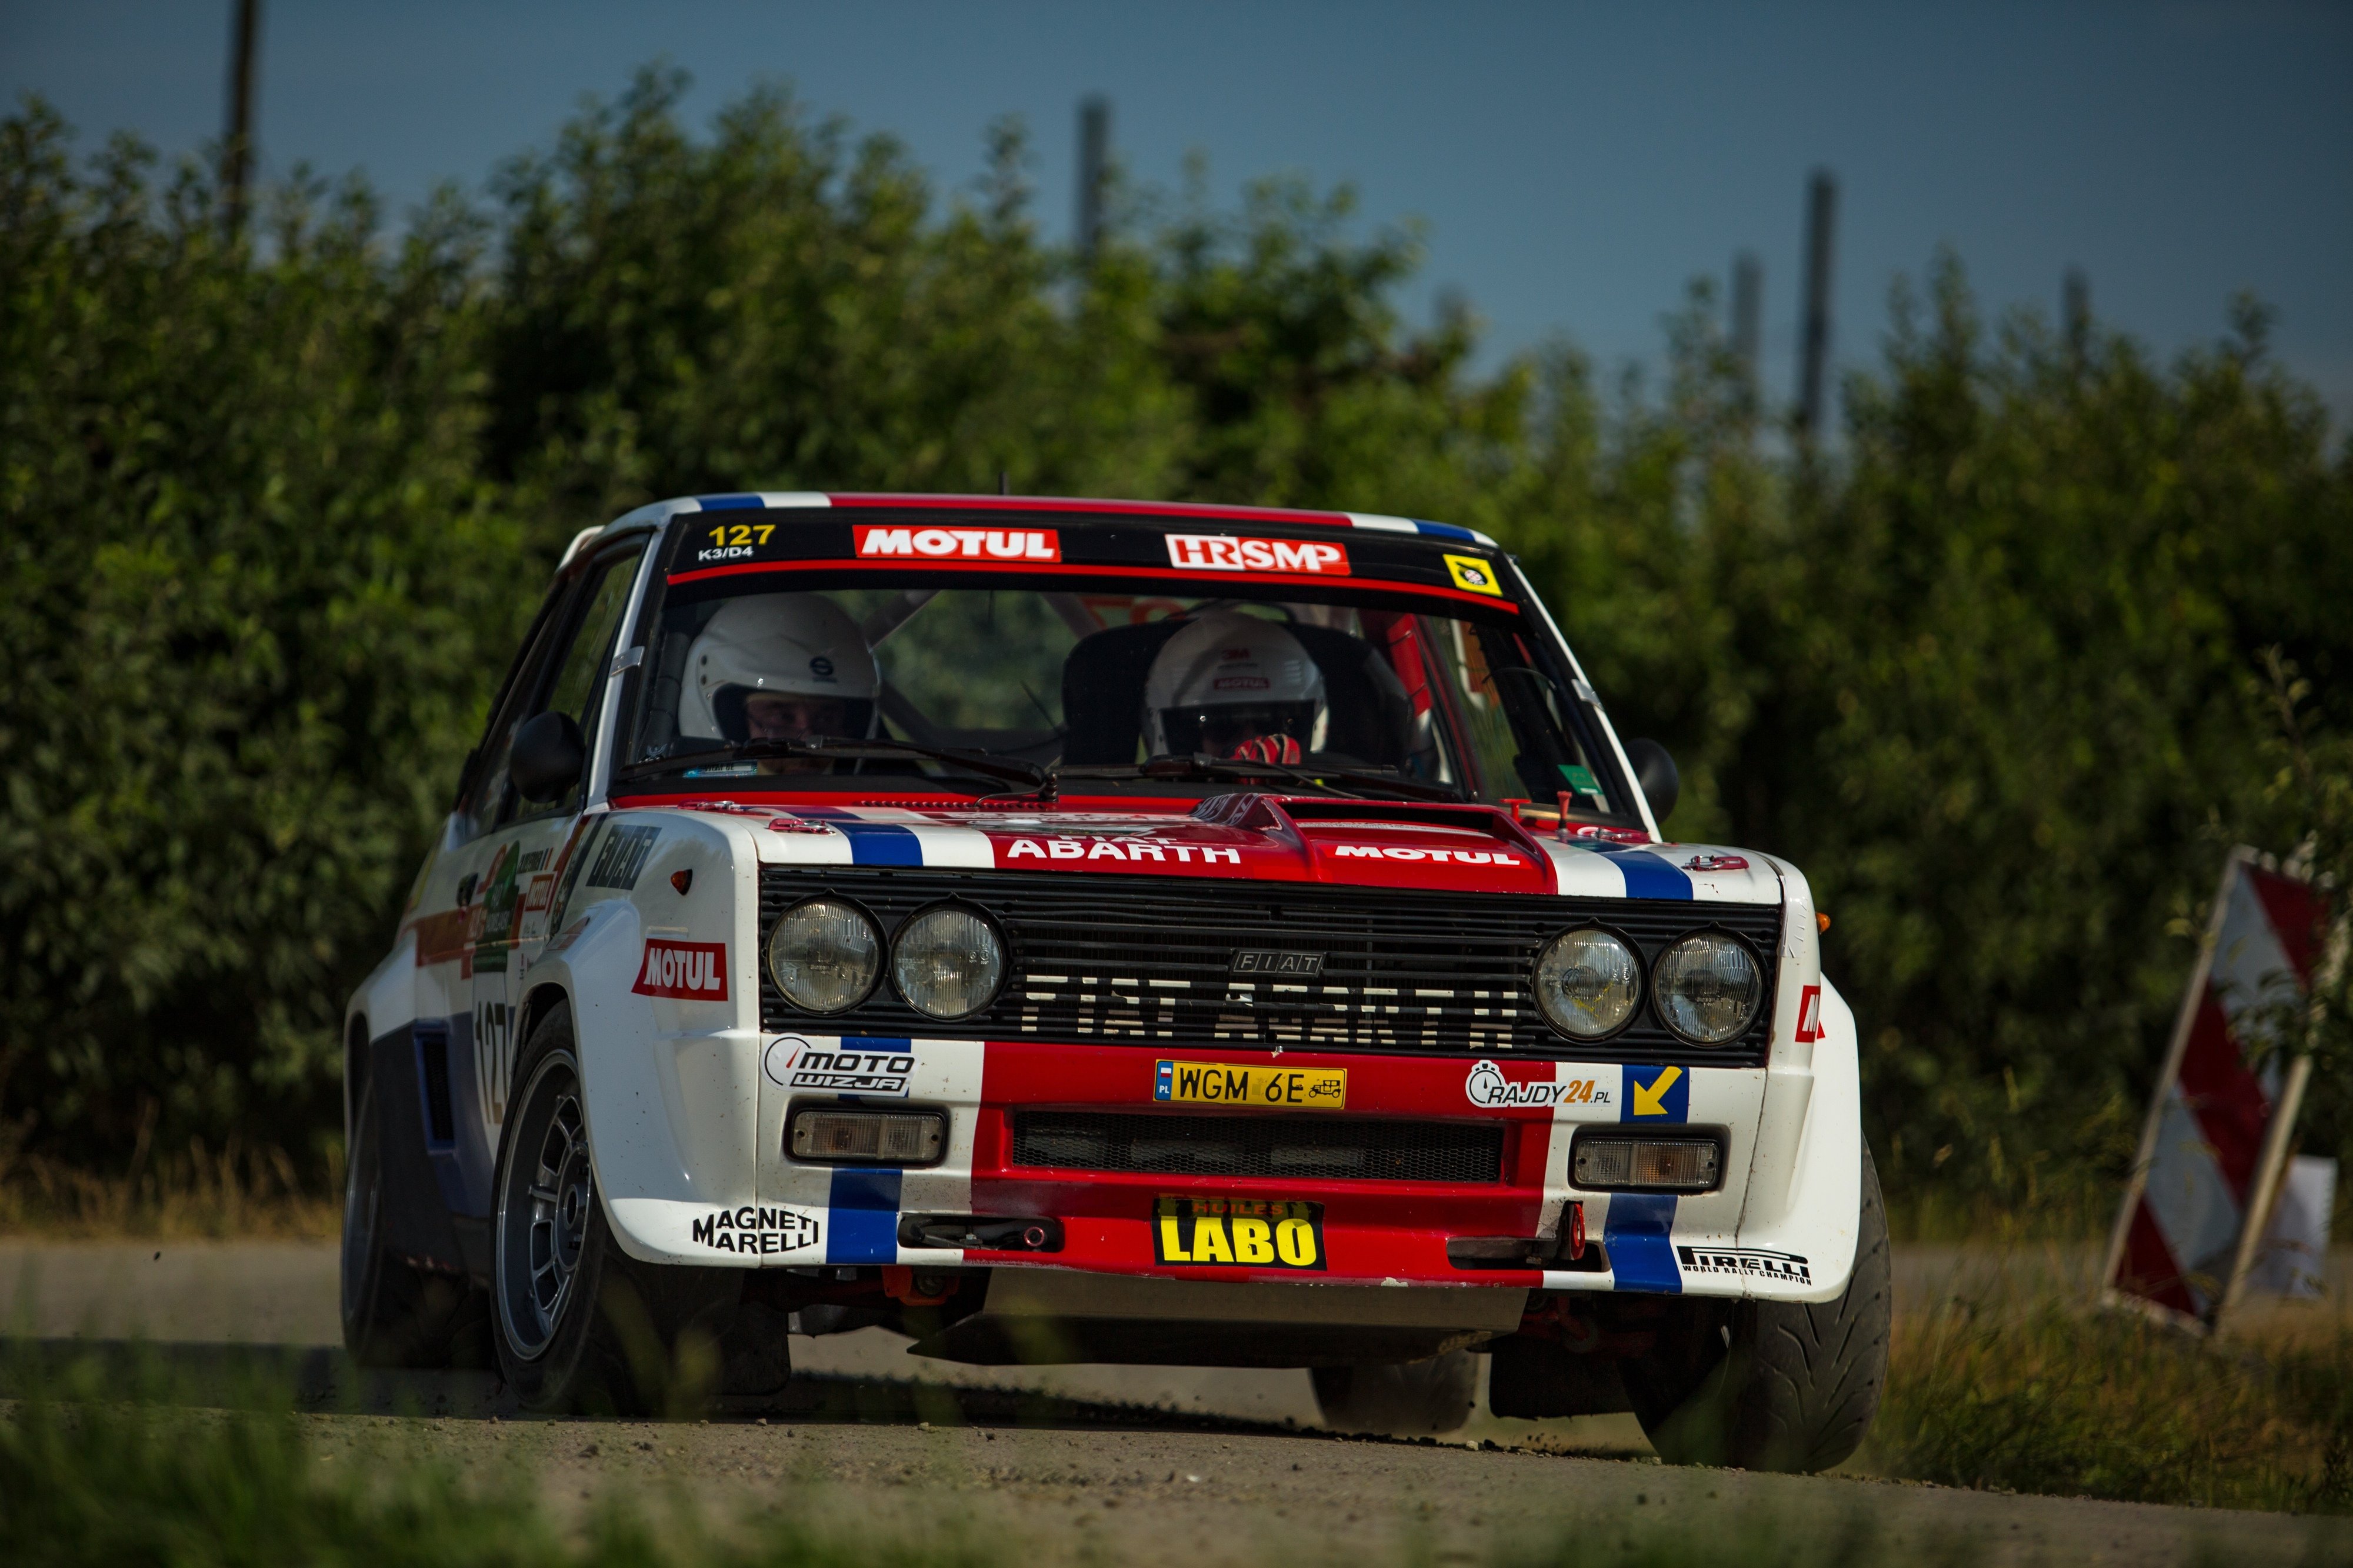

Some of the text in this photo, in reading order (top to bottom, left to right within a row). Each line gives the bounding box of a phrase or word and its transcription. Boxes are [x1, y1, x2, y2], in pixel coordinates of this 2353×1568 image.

[709, 524, 776, 546] 127
[861, 528, 1055, 558] MOTUL
[698, 546, 754, 561] K3/D4
[1176, 538, 1341, 571] HRSMP
[1006, 839, 1241, 864] ABARTH
[1058, 835, 1177, 845] FIAT
[593, 836, 652, 879] FIAT
[1335, 845, 1521, 866] MOTUL
[644, 948, 721, 991] MOTUL
[1239, 955, 1318, 973] FIAT
[475, 1000, 507, 1125] 127
[798, 1052, 915, 1073] MOTO
[793, 1074, 902, 1090] WIZJA
[1159, 1067, 1305, 1103] PL WGM 6E
[1487, 1080, 1611, 1104] RAJDY24.PL
[1192, 1202, 1284, 1215] HUILES
[692, 1206, 819, 1247] MAGNETI
[692, 1214, 819, 1255] MARELLI
[1161, 1216, 1317, 1266] LABO
[1676, 1246, 1811, 1279] PIRELLI
[1682, 1265, 1812, 1286] WORLD RALLY CHAMPION
